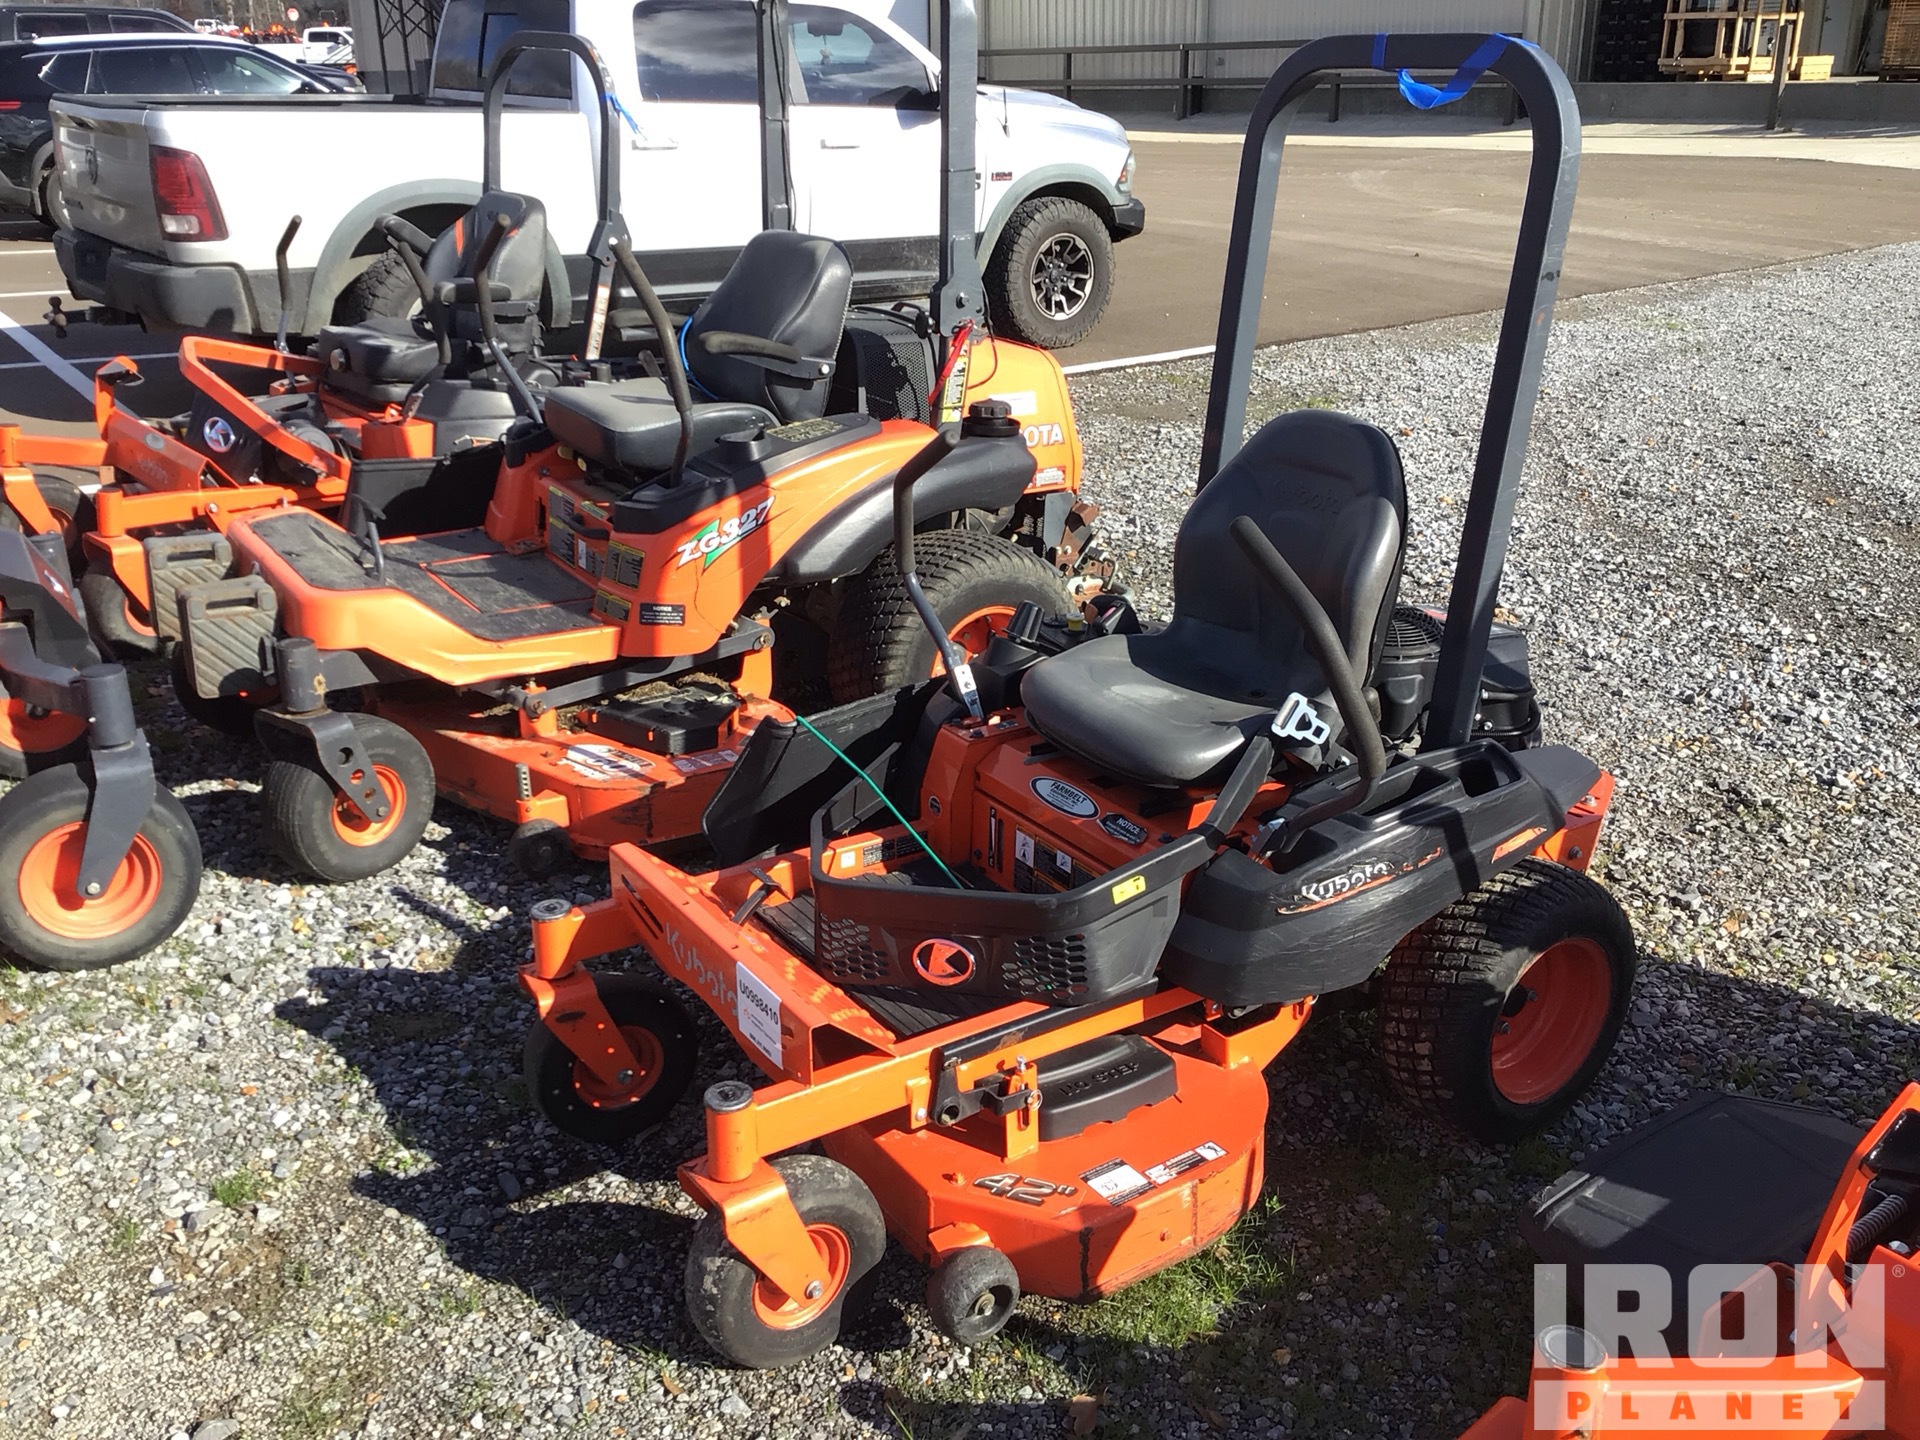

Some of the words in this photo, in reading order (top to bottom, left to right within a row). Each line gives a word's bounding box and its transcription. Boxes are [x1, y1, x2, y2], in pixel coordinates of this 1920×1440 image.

[1023, 423, 1064, 448] OTA
[1050, 781, 1088, 804] FARMBELT
[1116, 817, 1141, 835] NOTICE
